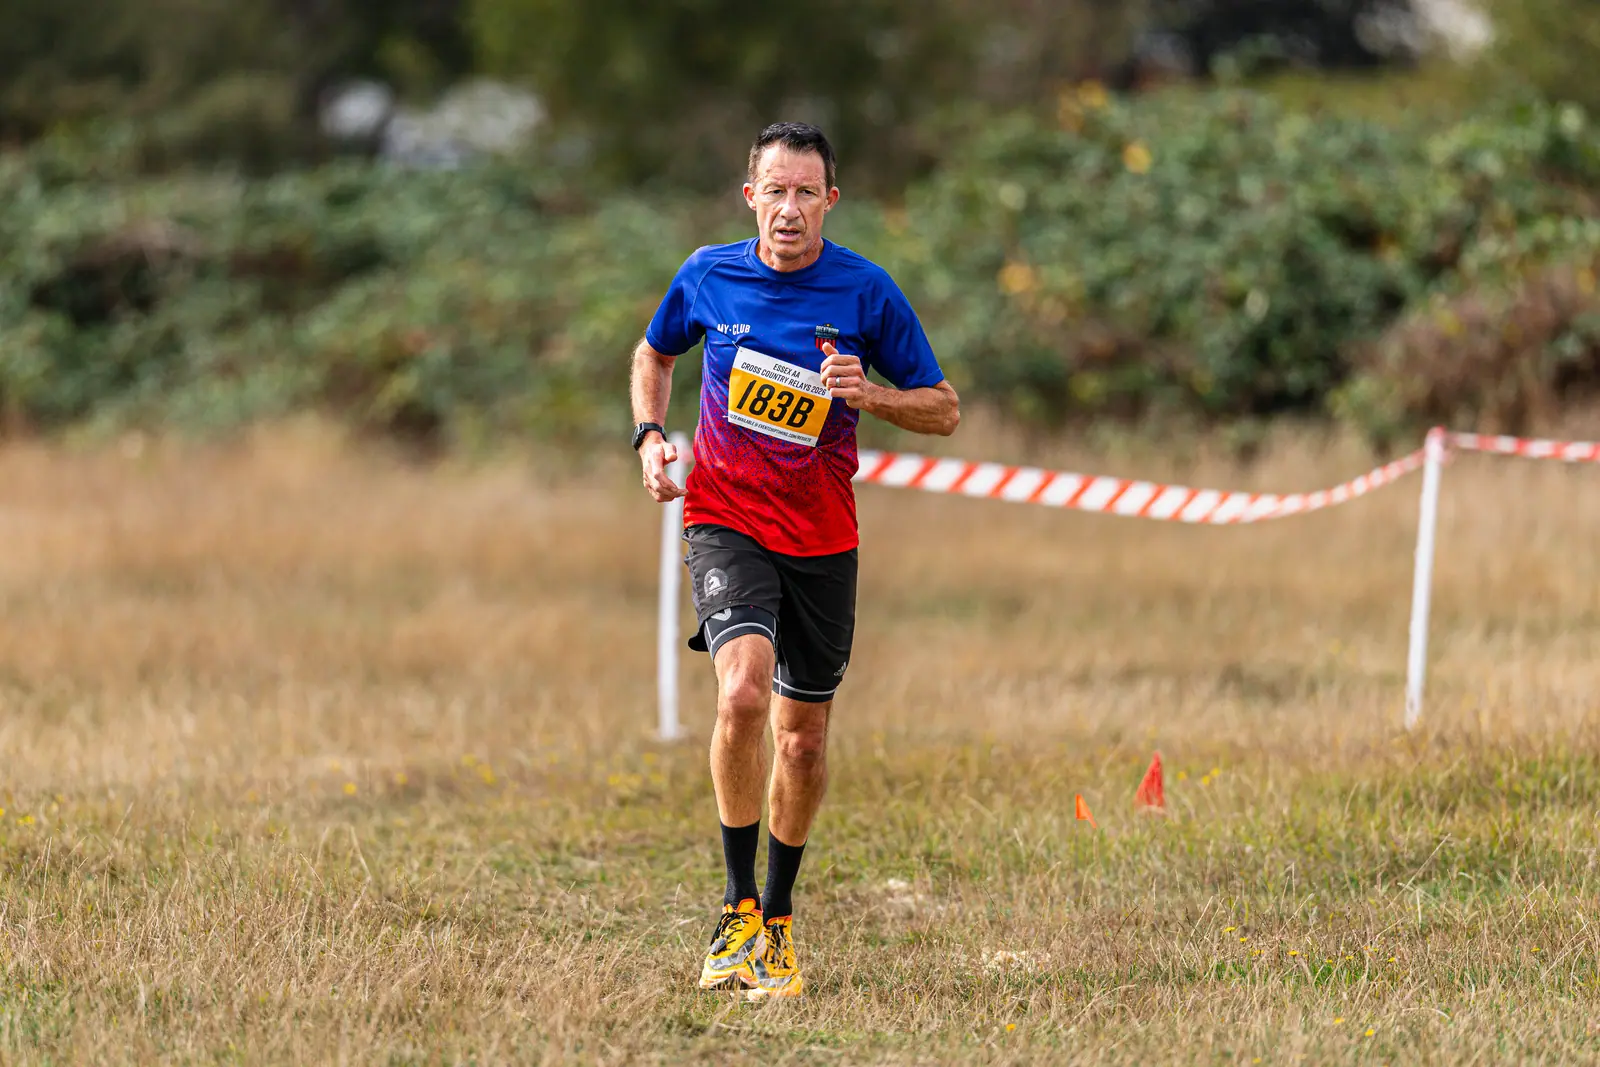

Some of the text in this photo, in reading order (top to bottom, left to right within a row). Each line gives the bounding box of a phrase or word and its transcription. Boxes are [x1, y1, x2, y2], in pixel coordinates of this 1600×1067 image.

[741, 362, 826, 396] CROSS COUNTRY RELAYS 2026
[773, 363, 792, 376] ESSEX
[736, 380, 815, 428] 183B
[737, 416, 755, 426] AVAILABLE
